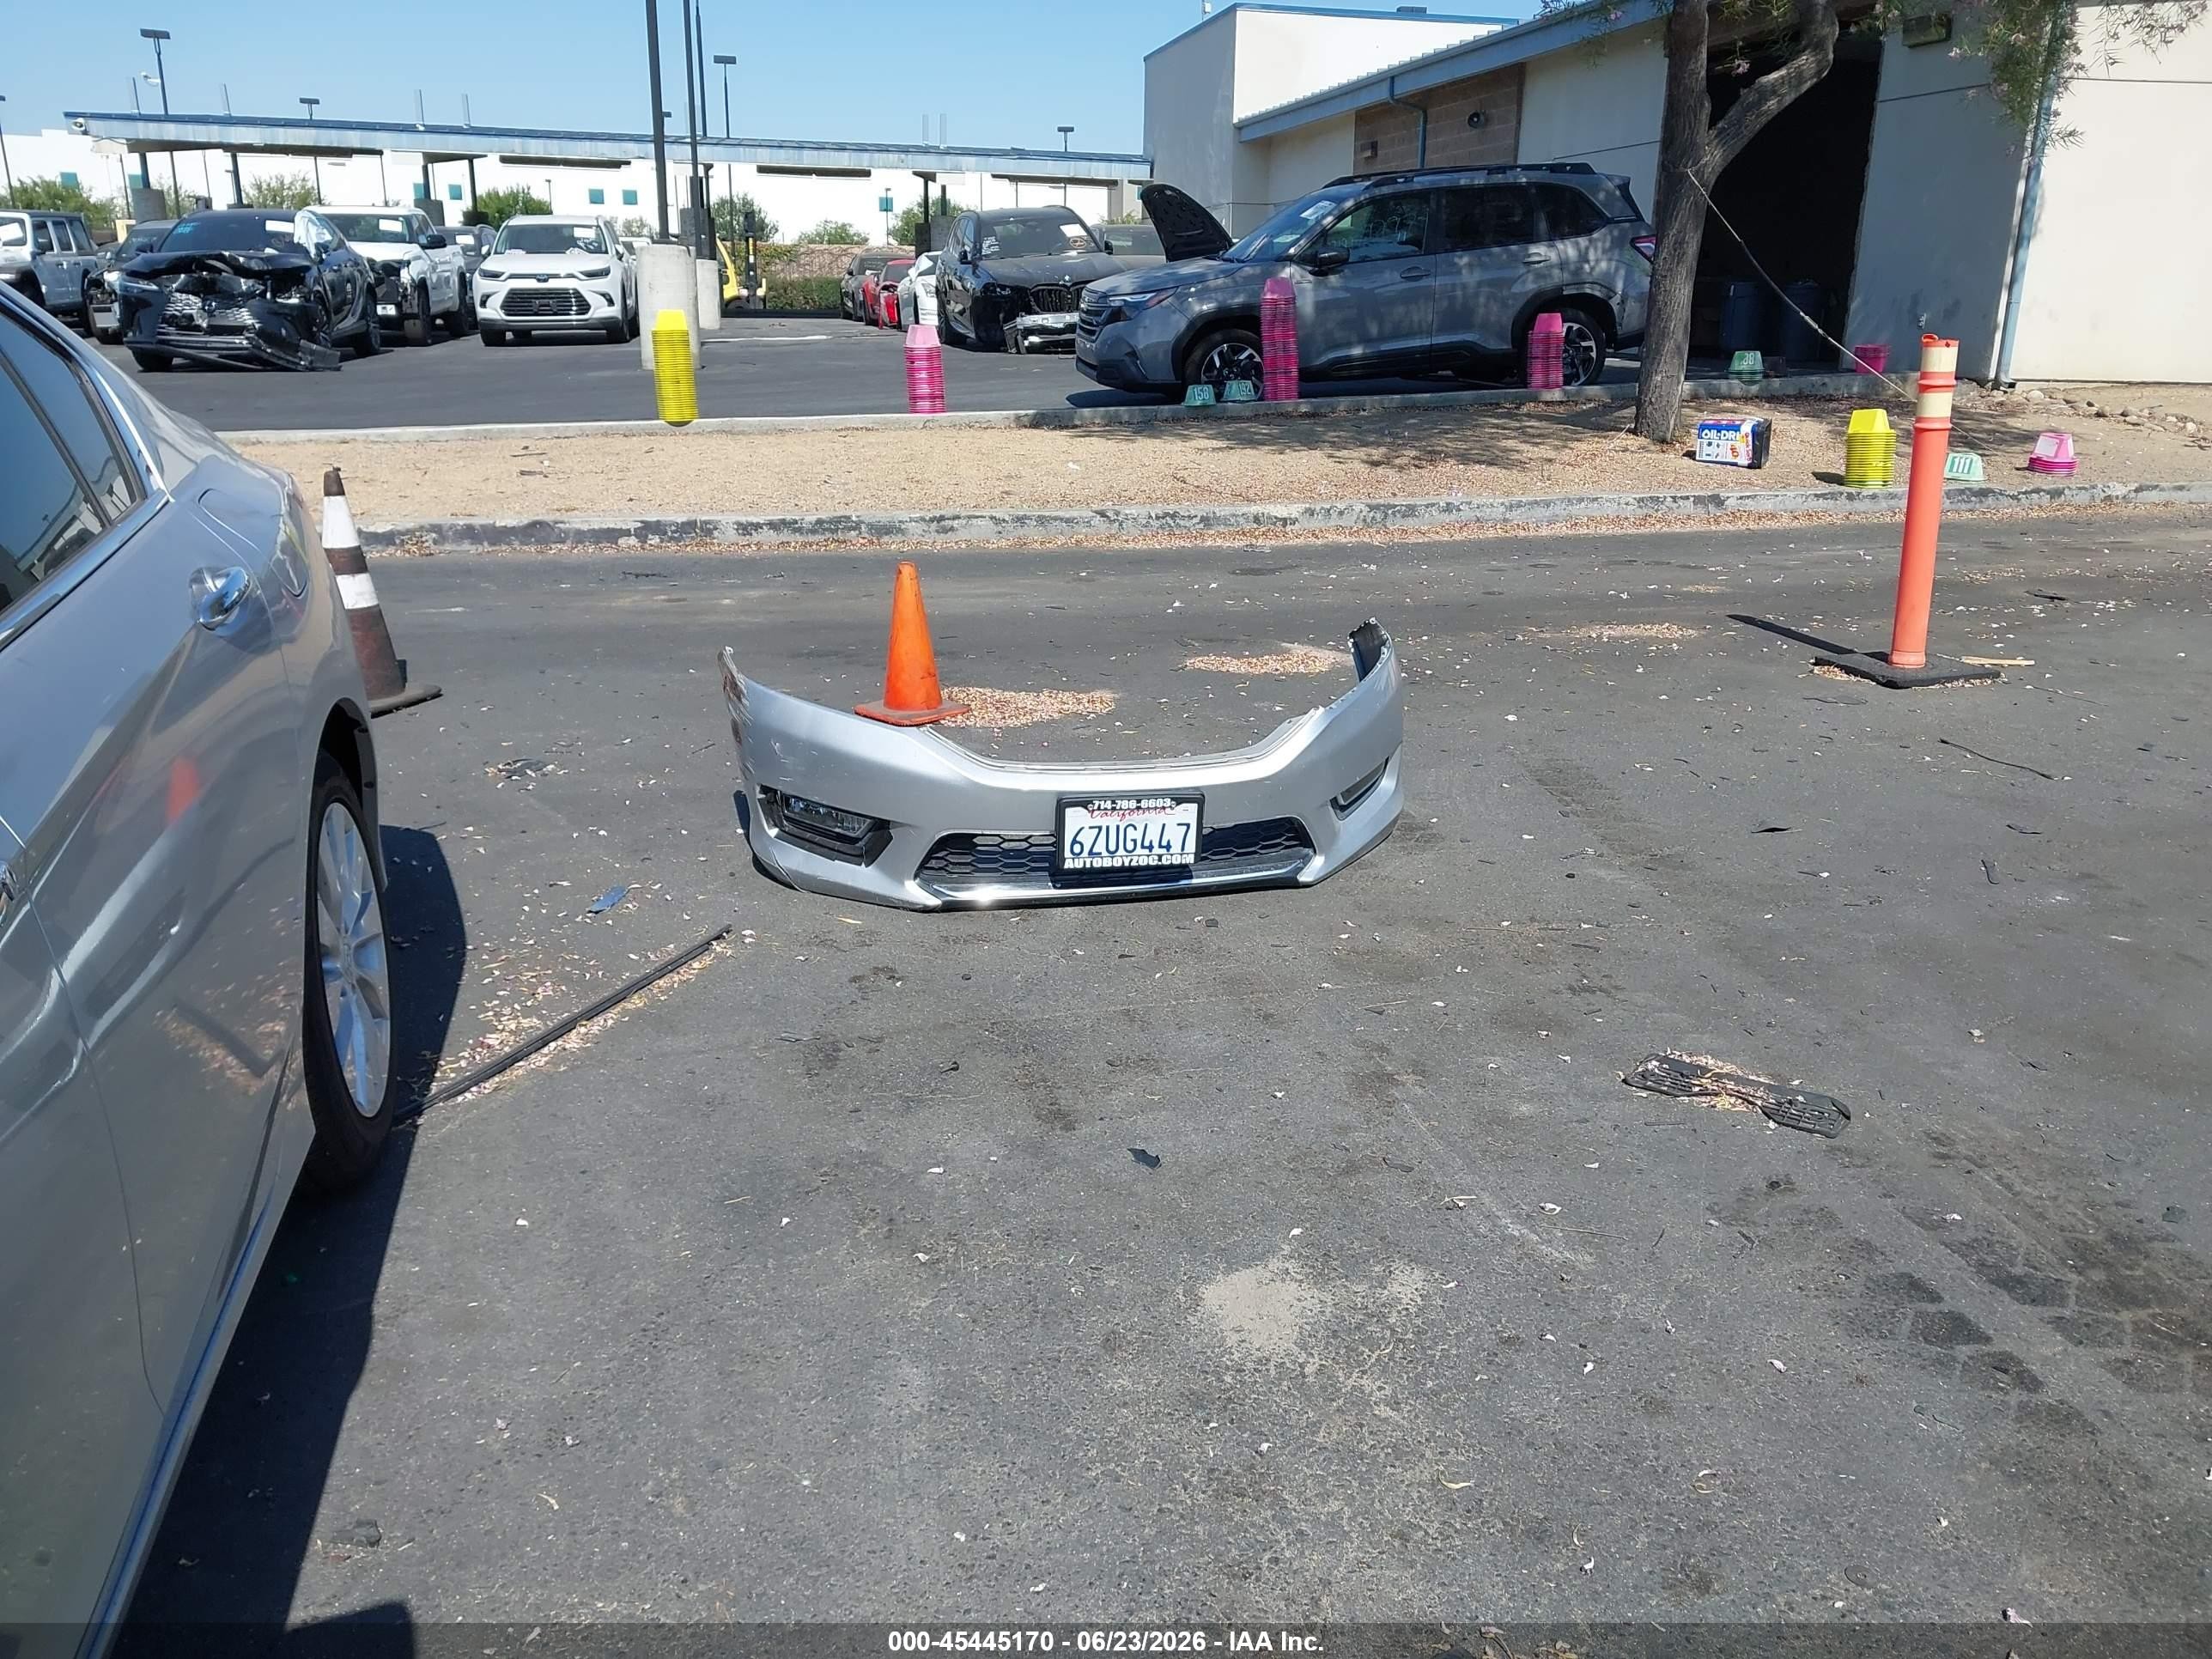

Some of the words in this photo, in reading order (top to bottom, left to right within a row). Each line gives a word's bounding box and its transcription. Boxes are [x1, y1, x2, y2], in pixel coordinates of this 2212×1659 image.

[1239, 383, 1251, 395] 192
[1952, 457, 1972, 473] 111
[1092, 798, 1171, 810] 714-786-6603
[1070, 823, 1191, 857] 6ZUG447
[1064, 854, 1194, 869] AUTOBOYZOC.COM
